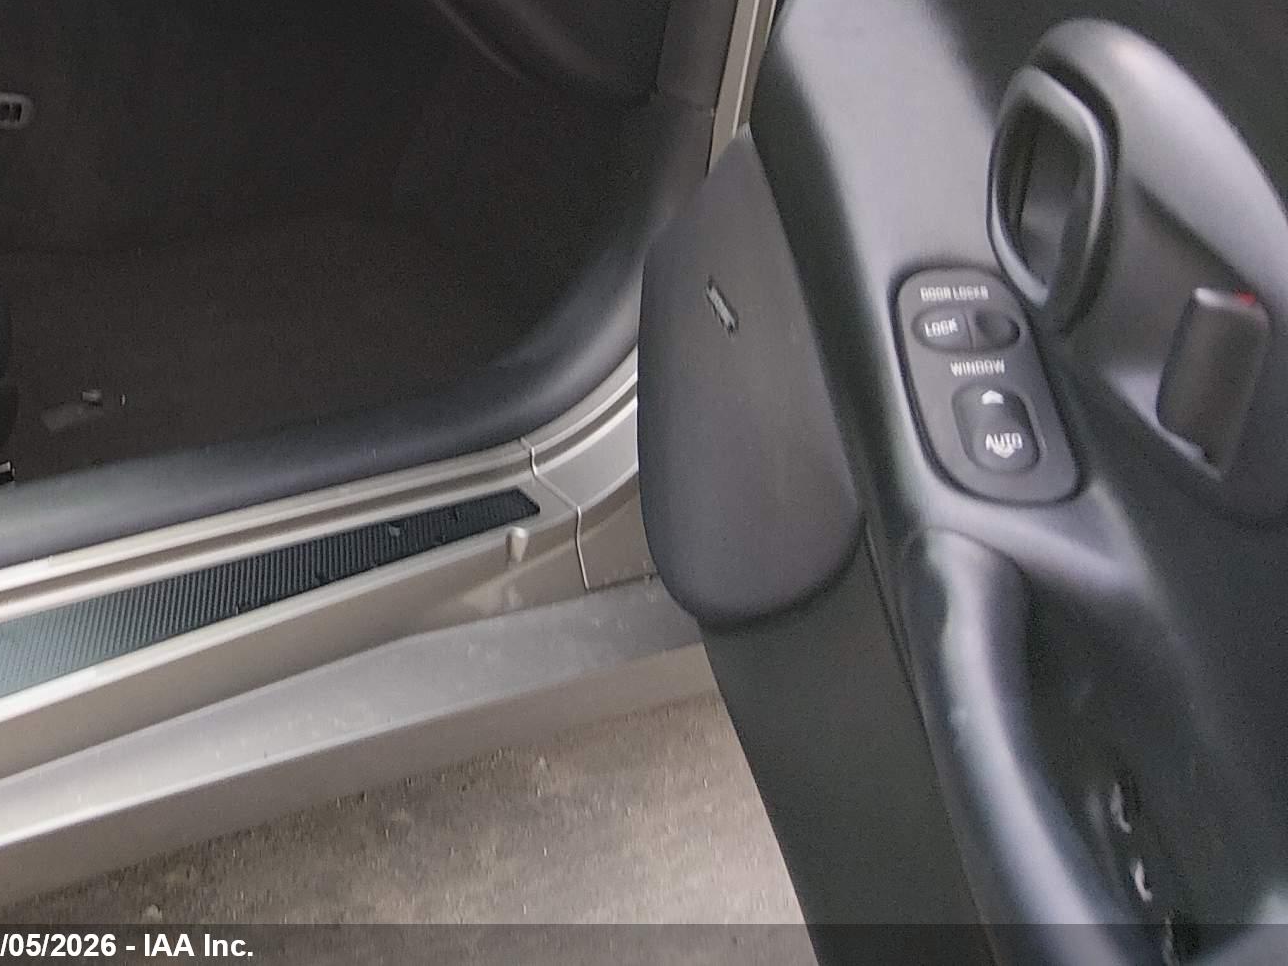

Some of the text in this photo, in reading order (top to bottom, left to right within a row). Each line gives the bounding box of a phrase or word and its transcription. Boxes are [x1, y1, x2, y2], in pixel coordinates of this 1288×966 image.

[920, 286, 952, 302] DOOR
[924, 318, 959, 337] LOCK
[950, 359, 1005, 377] WINDOW
[985, 432, 1023, 451] AUTO
